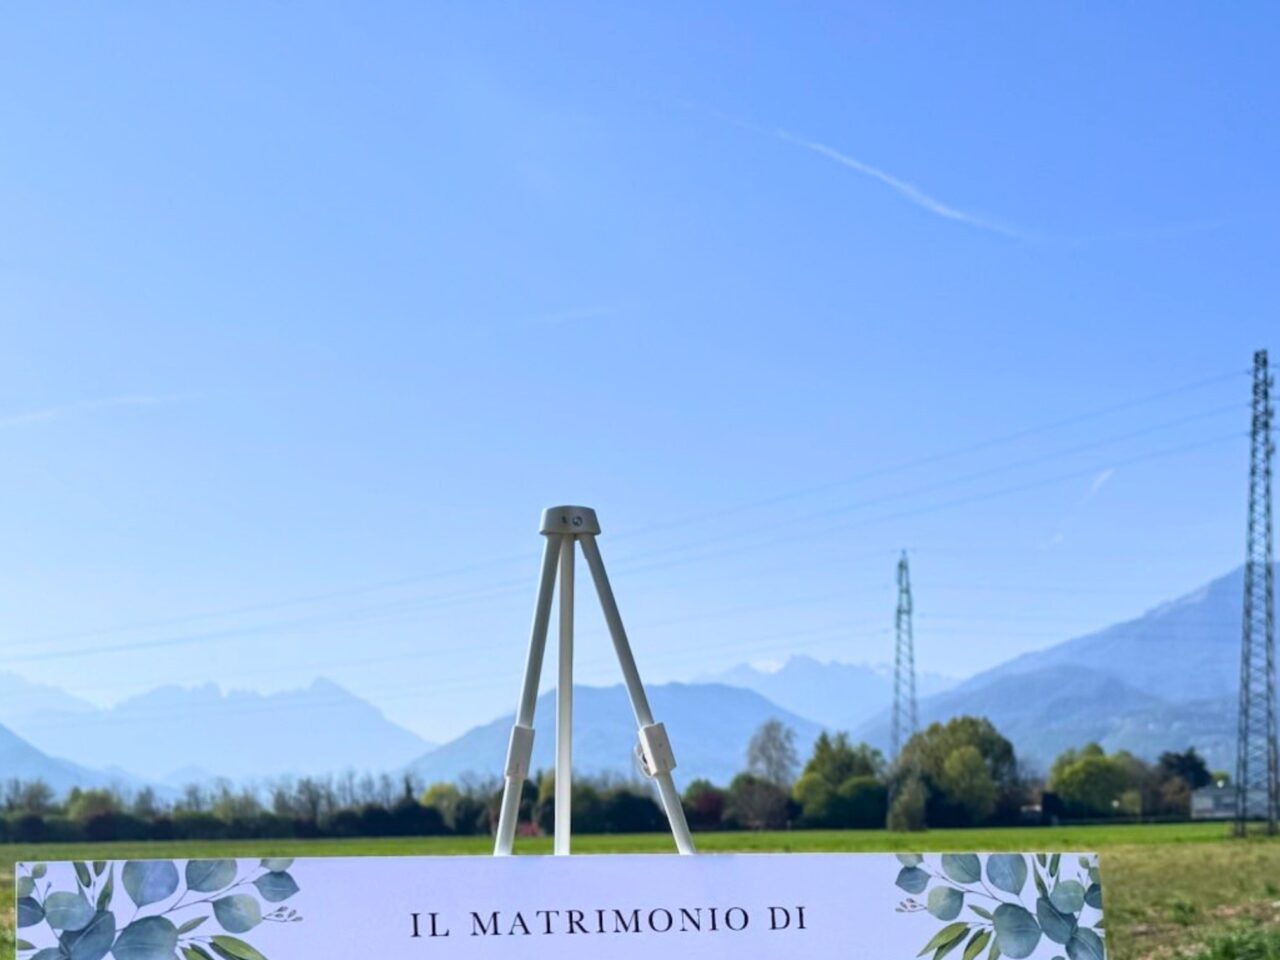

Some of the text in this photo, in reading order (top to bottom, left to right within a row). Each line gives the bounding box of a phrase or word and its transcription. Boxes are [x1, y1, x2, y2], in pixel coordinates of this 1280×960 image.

[411, 906, 806, 938] IL MATRIMONIO DI
